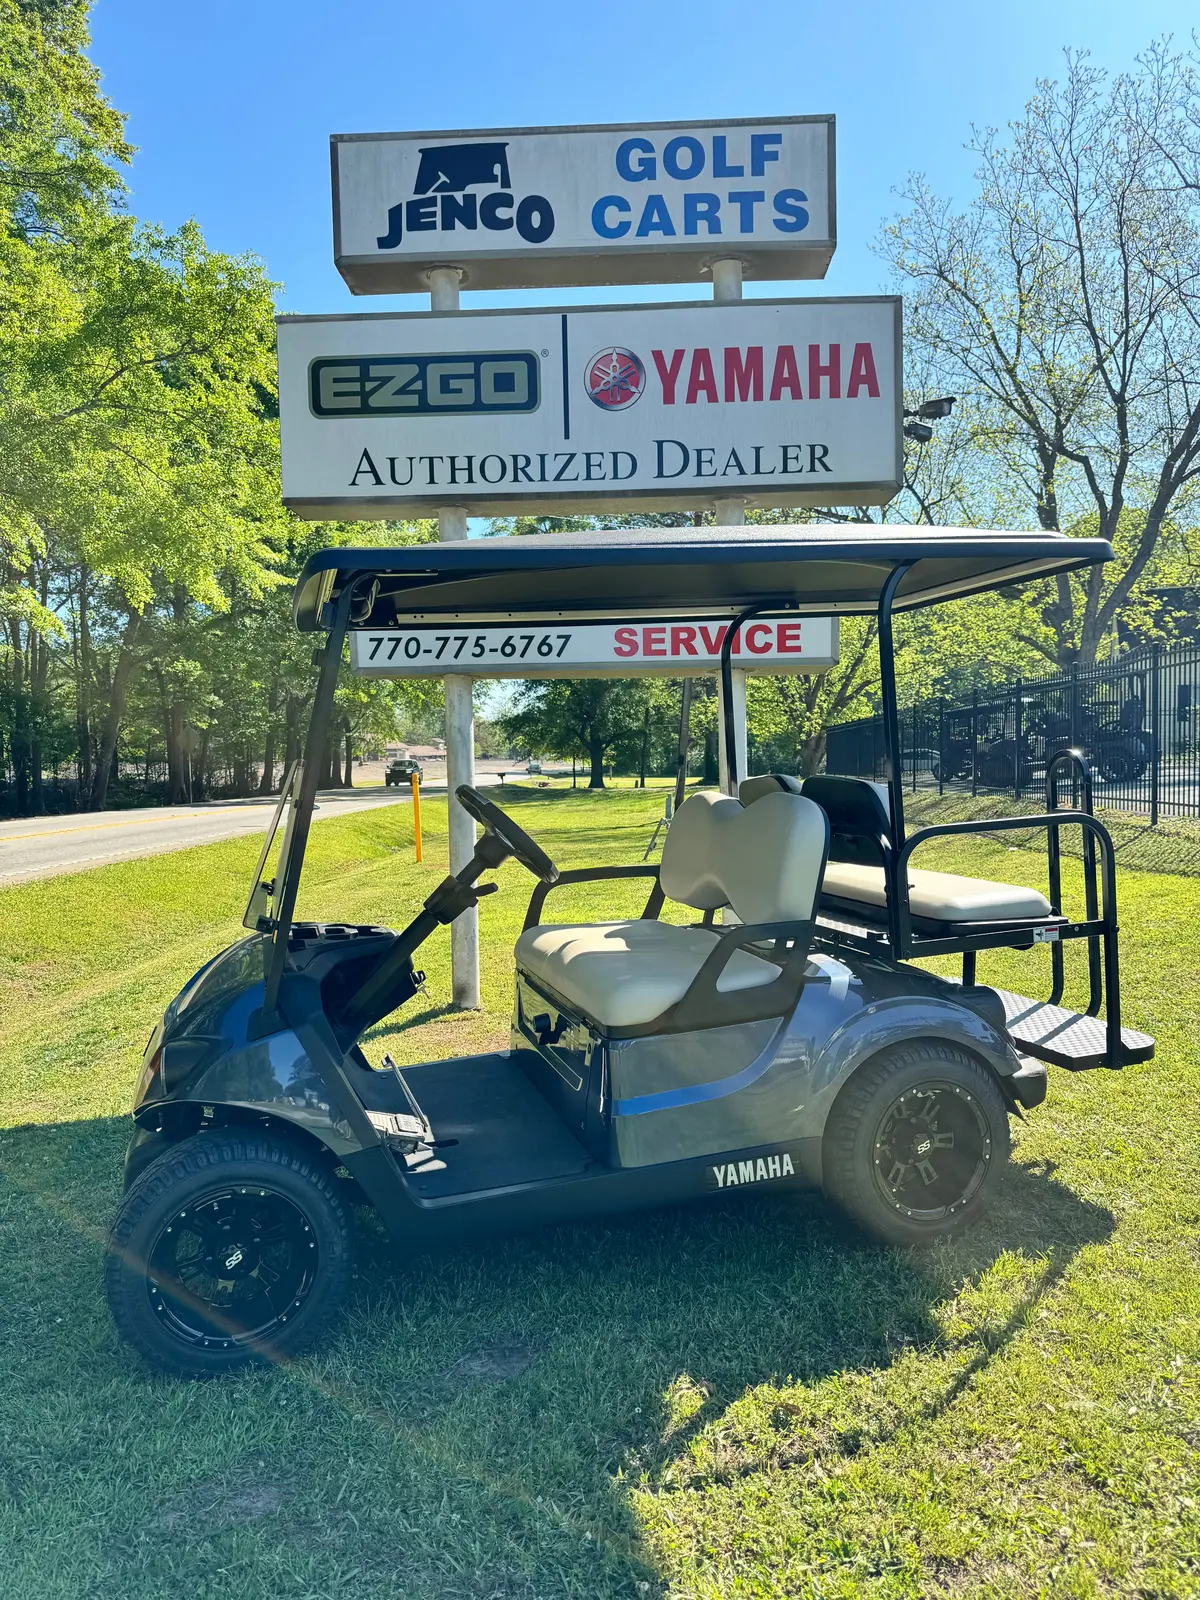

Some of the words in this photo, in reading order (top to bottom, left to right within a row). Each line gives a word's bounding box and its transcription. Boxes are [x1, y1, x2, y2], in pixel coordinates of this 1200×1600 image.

[616, 134, 782, 182] GOLF
[376, 192, 555, 249] JENCO
[591, 188, 810, 239] CARTS
[651, 342, 880, 405] YAMAHA
[348, 447, 638, 486] AUTHORIZED
[652, 439, 833, 479] DEALER
[368, 634, 573, 661] 770-775-6767
[613, 623, 801, 657] SERVICE
[712, 1153, 795, 1187] YAMAHA
